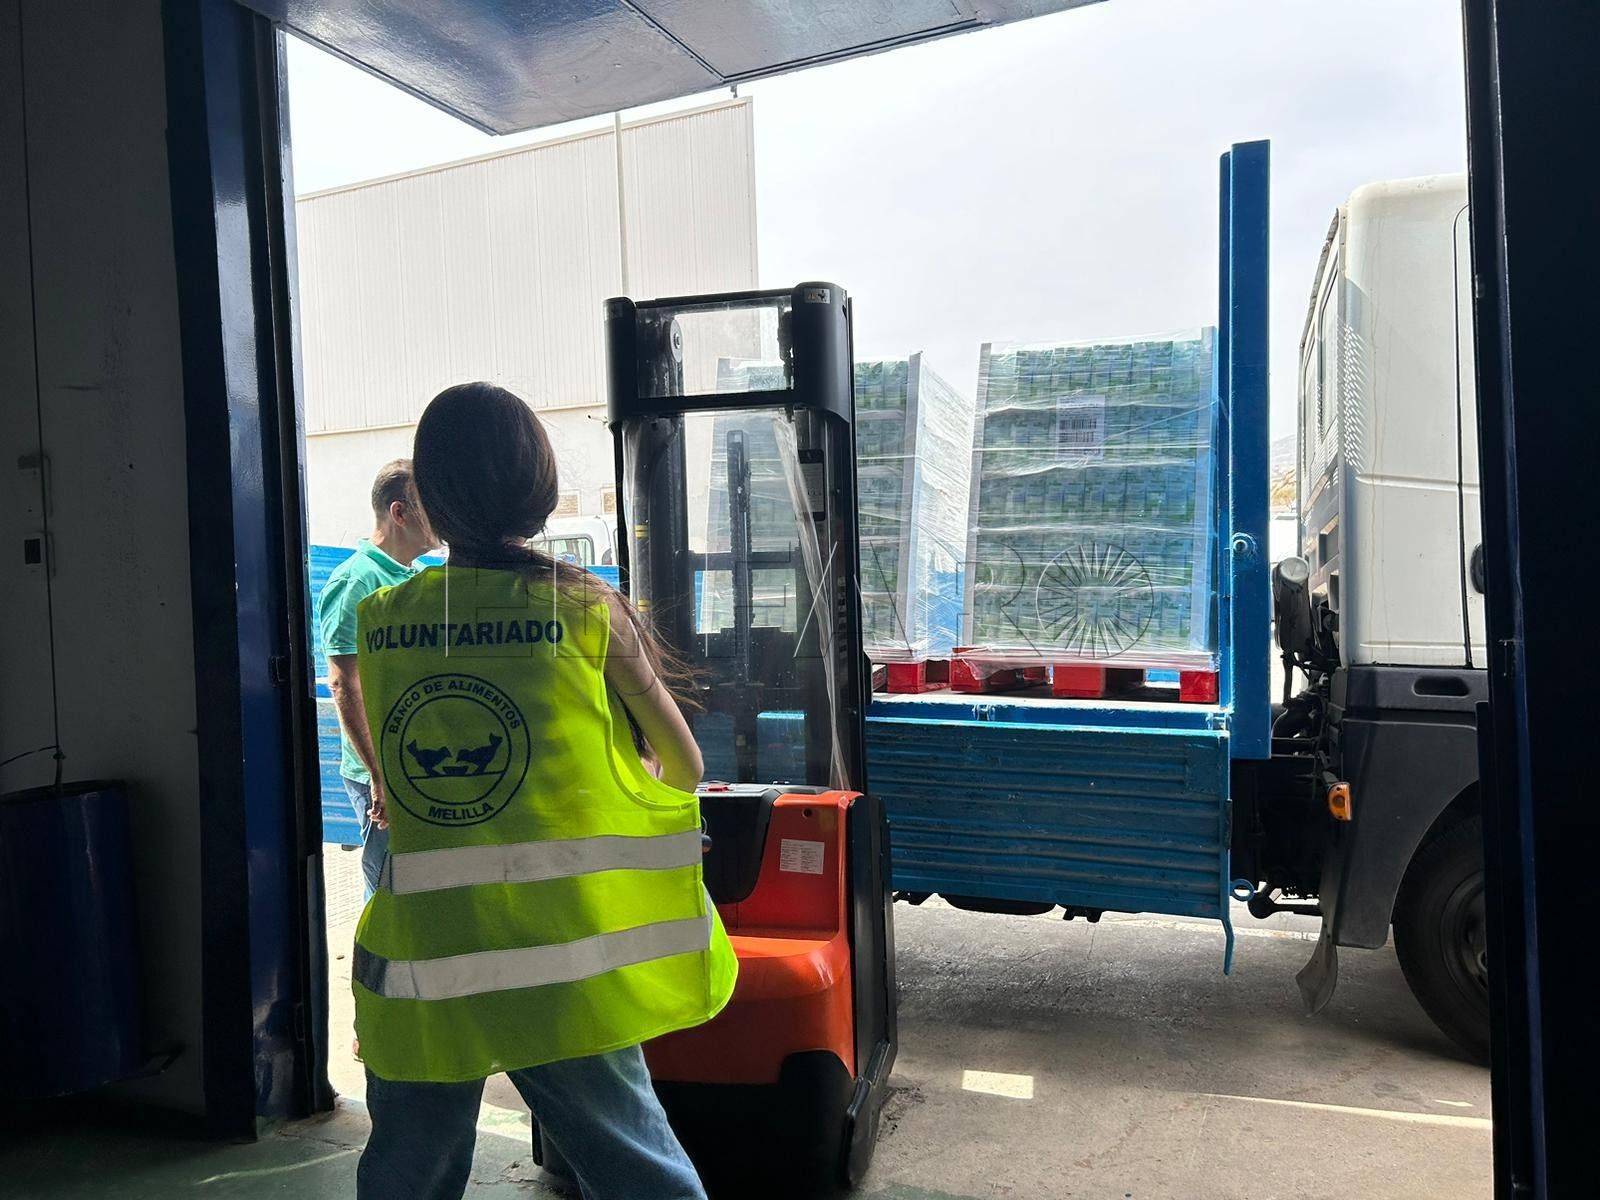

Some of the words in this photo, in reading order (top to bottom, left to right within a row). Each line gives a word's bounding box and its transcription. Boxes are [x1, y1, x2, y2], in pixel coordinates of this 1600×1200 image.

[366, 620, 563, 653] VOLUNTARIADO
[388, 691, 421, 734] BANCO
[423, 681, 444, 695] DE
[448, 680, 520, 729] ALIMENTOS
[428, 802, 494, 820] MELILLA
